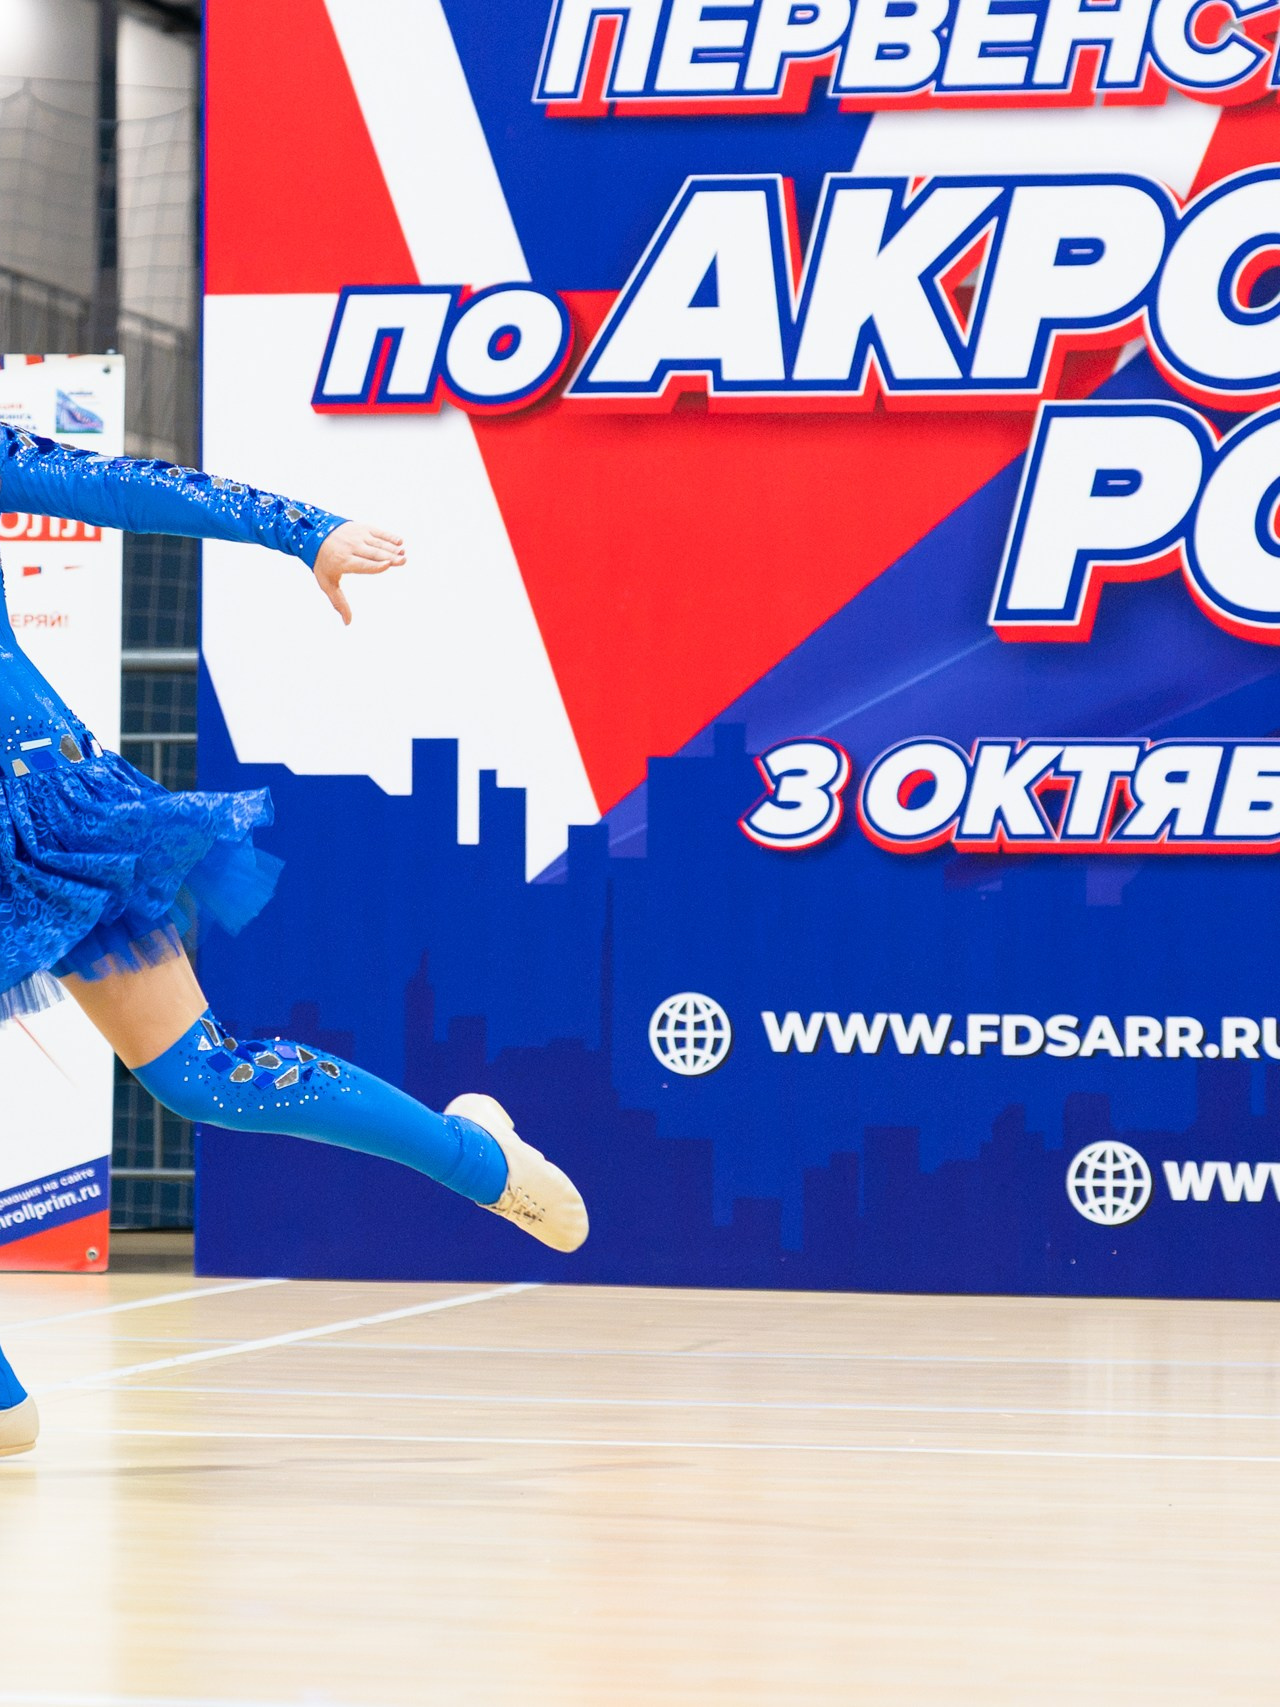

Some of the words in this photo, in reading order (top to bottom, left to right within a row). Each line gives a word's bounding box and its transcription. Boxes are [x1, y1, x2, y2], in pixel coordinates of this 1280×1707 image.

[738, 736, 852, 850] 3
[43, 1181, 59, 1192] на
[60, 1168, 96, 1187] сайте
